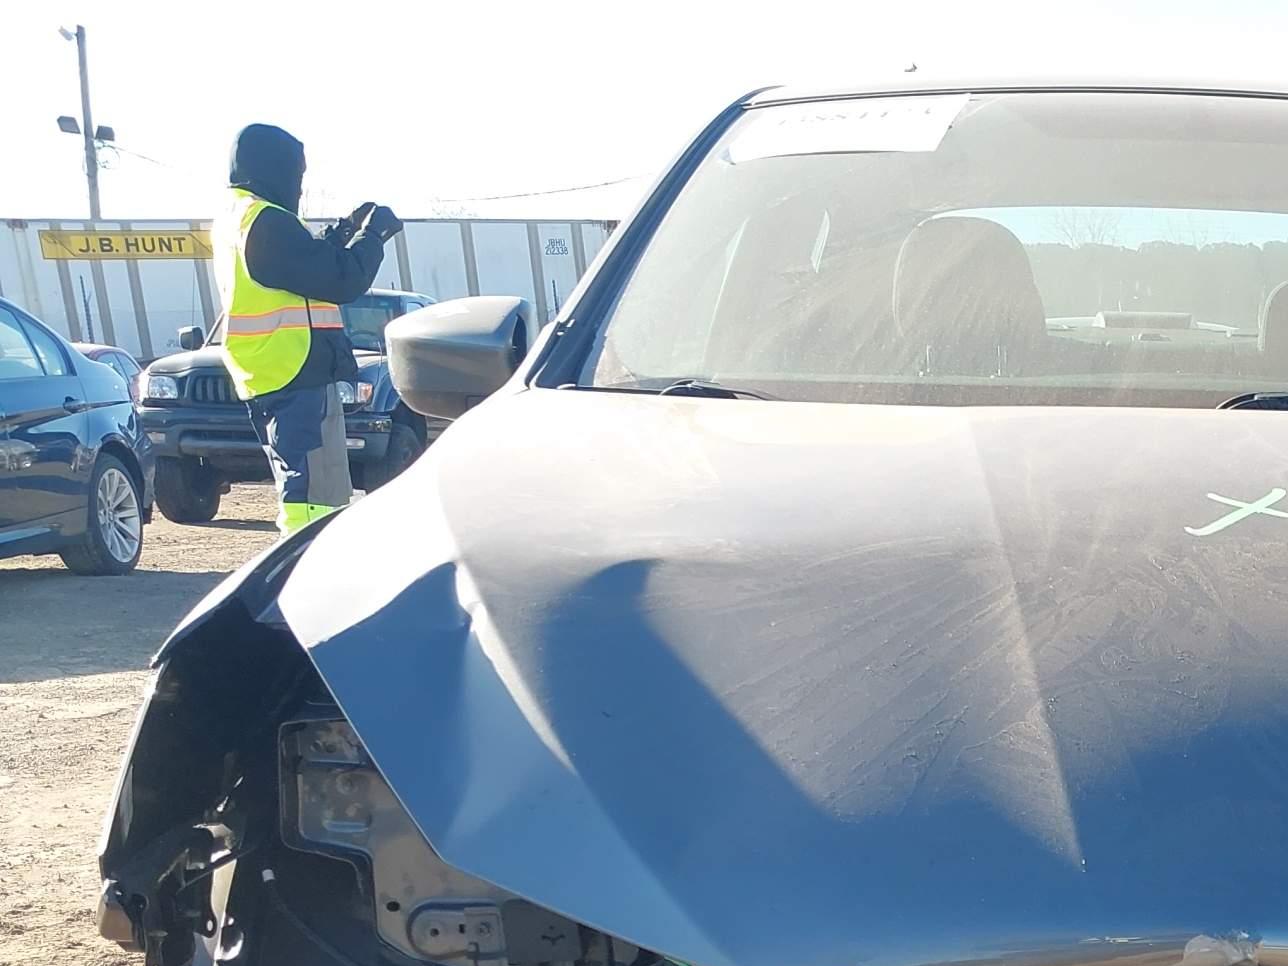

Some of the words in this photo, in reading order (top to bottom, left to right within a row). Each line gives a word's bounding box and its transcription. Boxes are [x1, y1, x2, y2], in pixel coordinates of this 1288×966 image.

[78, 237, 119, 253] J.B.
[125, 237, 187, 253] HUNT
[547, 238, 566, 247] JBHU
